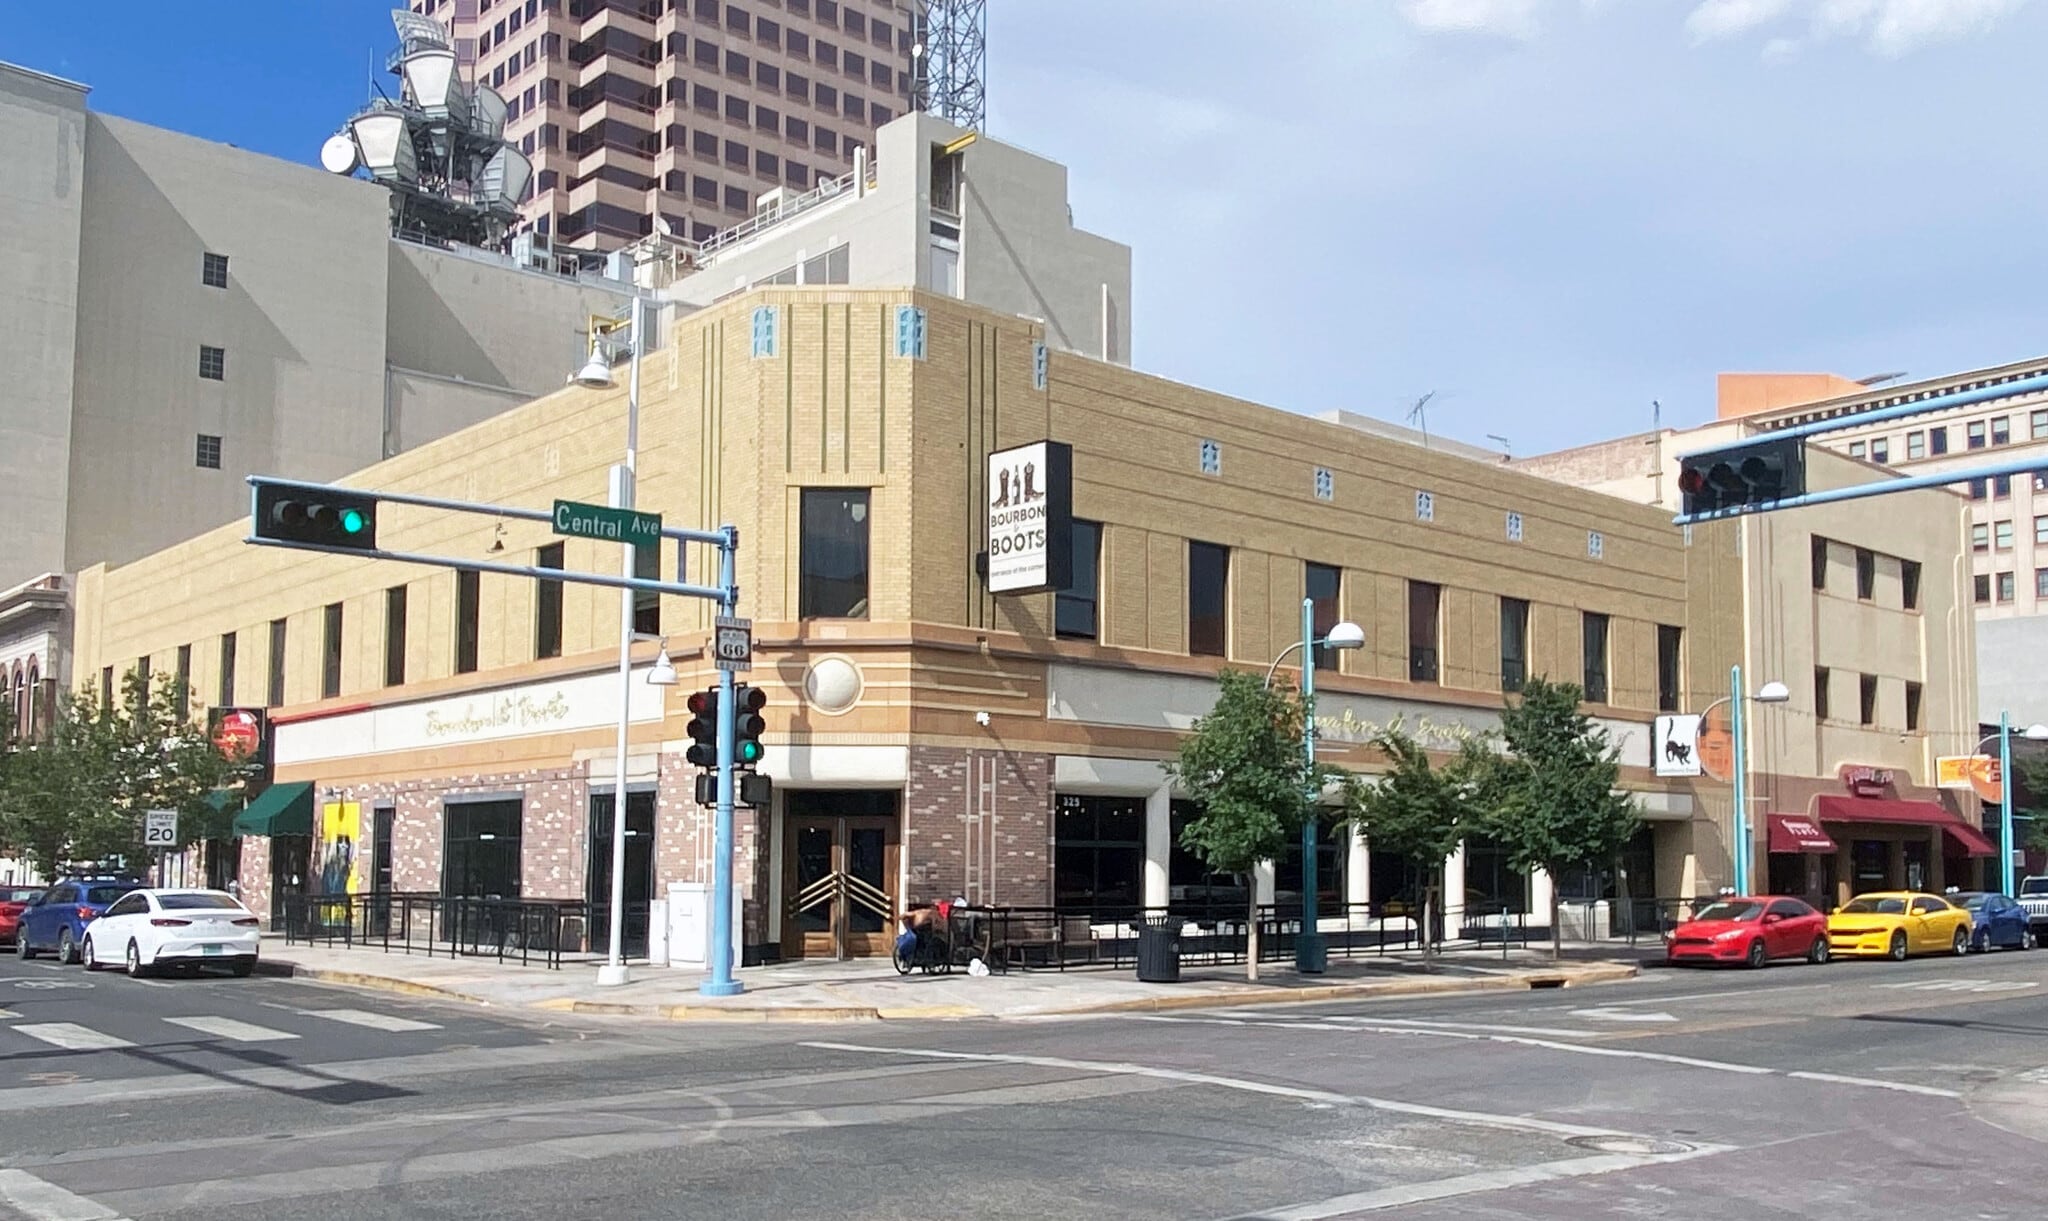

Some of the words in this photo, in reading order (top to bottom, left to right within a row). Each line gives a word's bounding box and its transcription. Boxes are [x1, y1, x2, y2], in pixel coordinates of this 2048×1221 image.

[556, 504, 622, 537] Central
[632, 515, 660, 536] Ave
[991, 505, 1046, 528] BOURBON
[991, 529, 1046, 556] BOOTS
[723, 644, 745, 657] 66
[148, 828, 174, 841] 20
